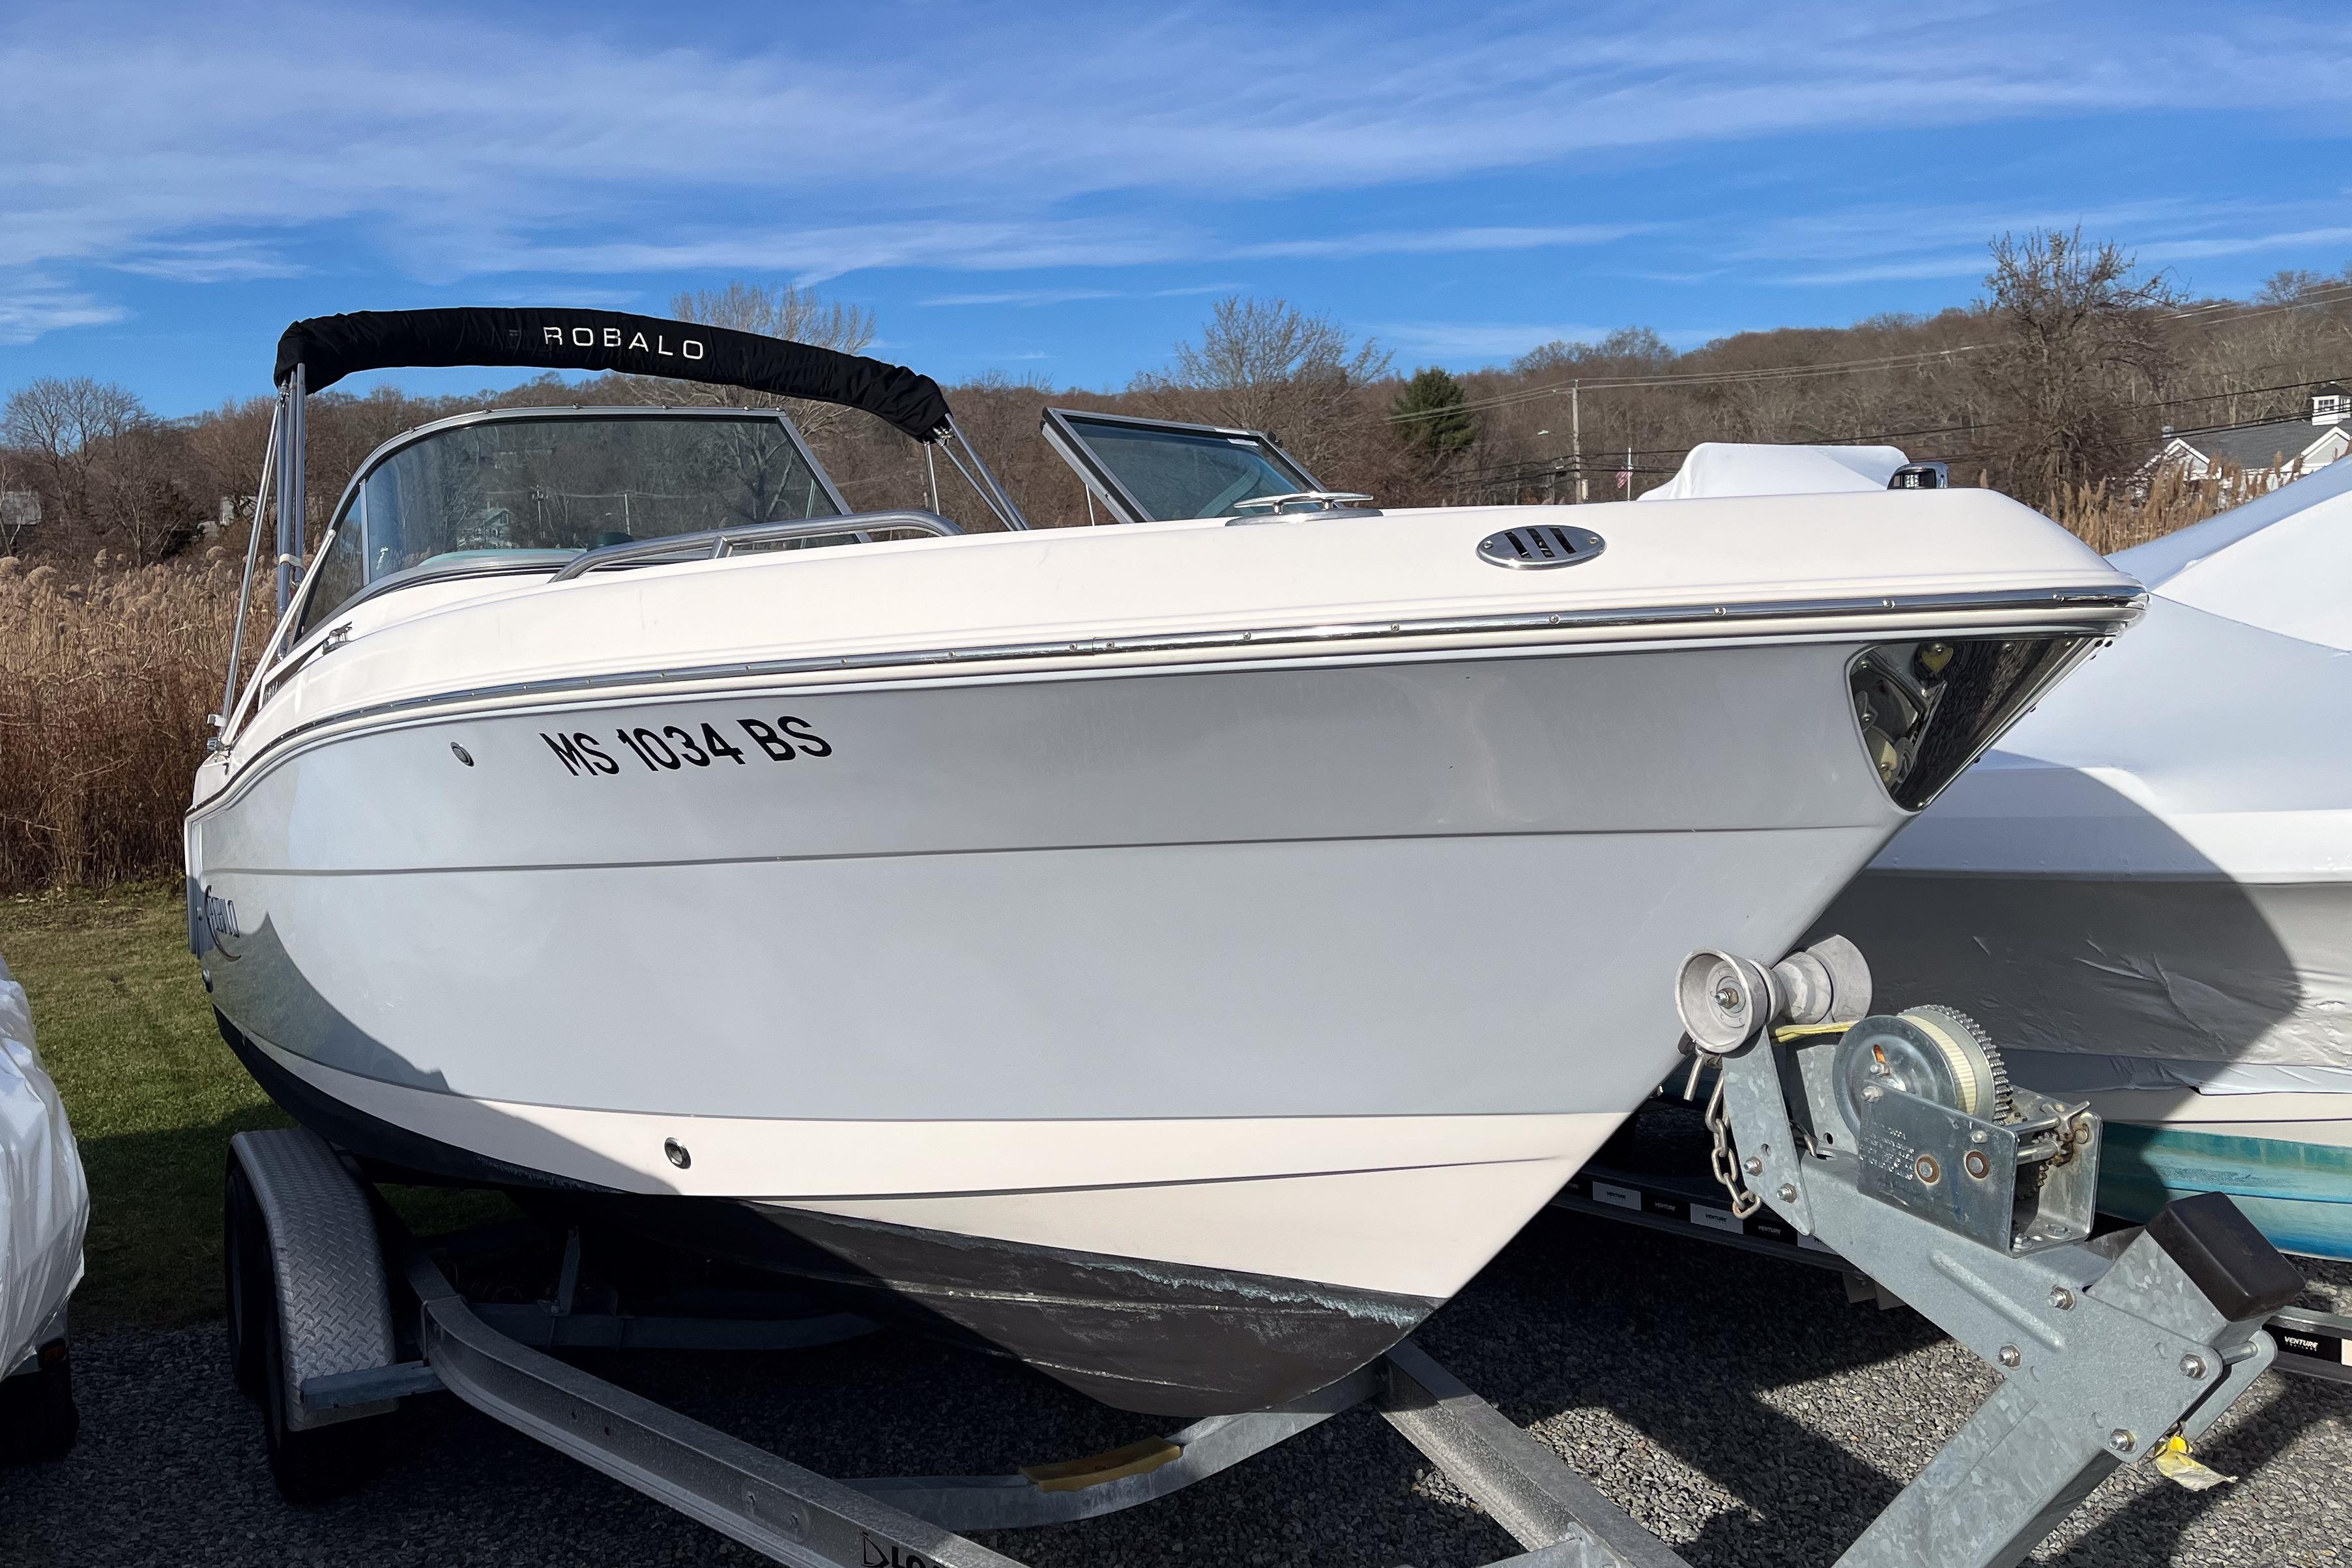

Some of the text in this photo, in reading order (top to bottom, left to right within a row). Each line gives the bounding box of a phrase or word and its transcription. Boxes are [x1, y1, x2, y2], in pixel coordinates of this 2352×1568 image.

[543, 327, 704, 360] ROBALO
[539, 716, 833, 776] MS 1034 BS
[2284, 1336, 2318, 1348] VENTURE
